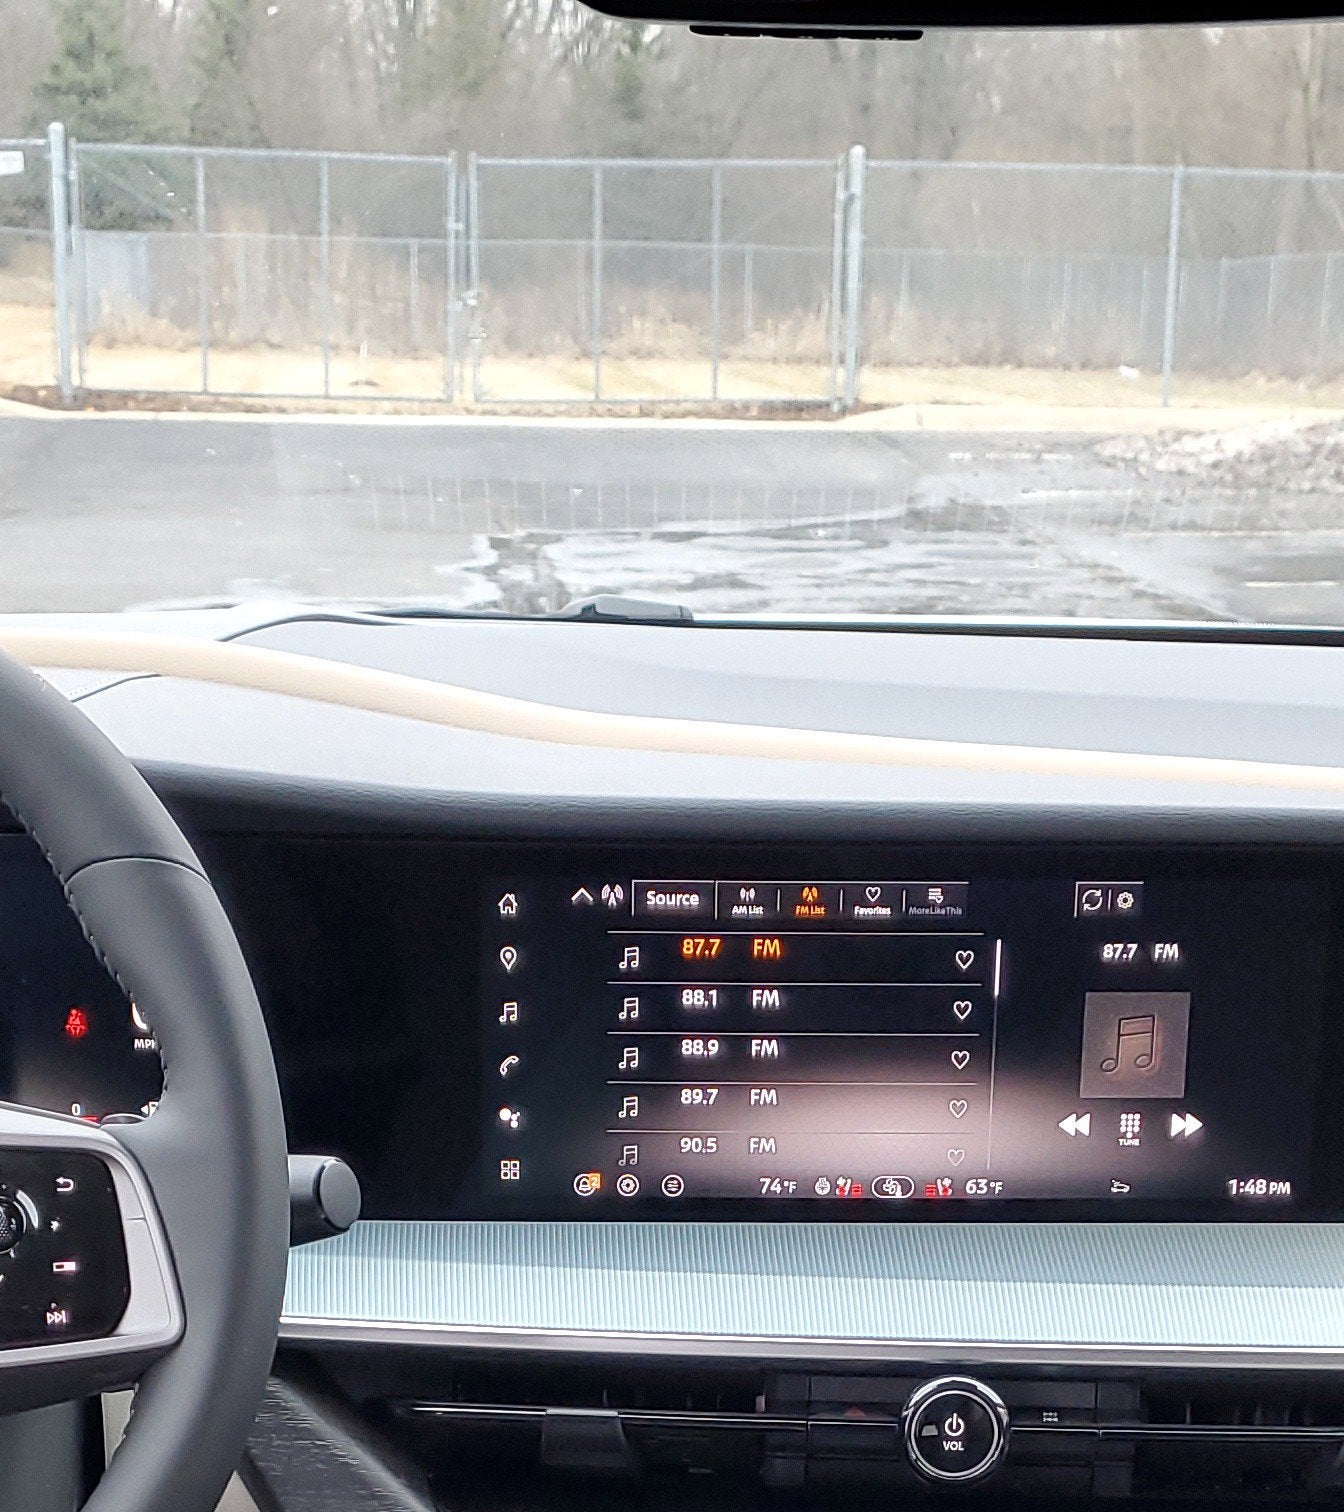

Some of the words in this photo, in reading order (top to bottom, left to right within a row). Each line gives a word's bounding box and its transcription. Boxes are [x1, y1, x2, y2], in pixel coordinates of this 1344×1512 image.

[646, 891, 699, 907] Source
[731, 906, 747, 915] AM
[748, 906, 764, 915] List
[795, 906, 809, 915] FM
[810, 906, 826, 915] List
[854, 906, 891, 915] Favorites
[682, 938, 721, 956] 87.7
[753, 938, 781, 958] FM
[1103, 943, 1137, 958] 87.7
[1154, 943, 1179, 959] FM
[681, 989, 718, 1007] 88.1
[752, 989, 780, 1007] FM
[681, 1039, 719, 1056] 88.9
[751, 1040, 779, 1057] FM
[680, 1089, 718, 1105] 89.7
[749, 1089, 777, 1106] FM
[71, 1103, 81, 1116] 0
[680, 1137, 717, 1154] 90.5
[749, 1137, 776, 1154] FM
[1118, 1138, 1140, 1146] TUNE
[1229, 1179, 1267, 1195] 1:48
[942, 1441, 964, 1451] VOL
